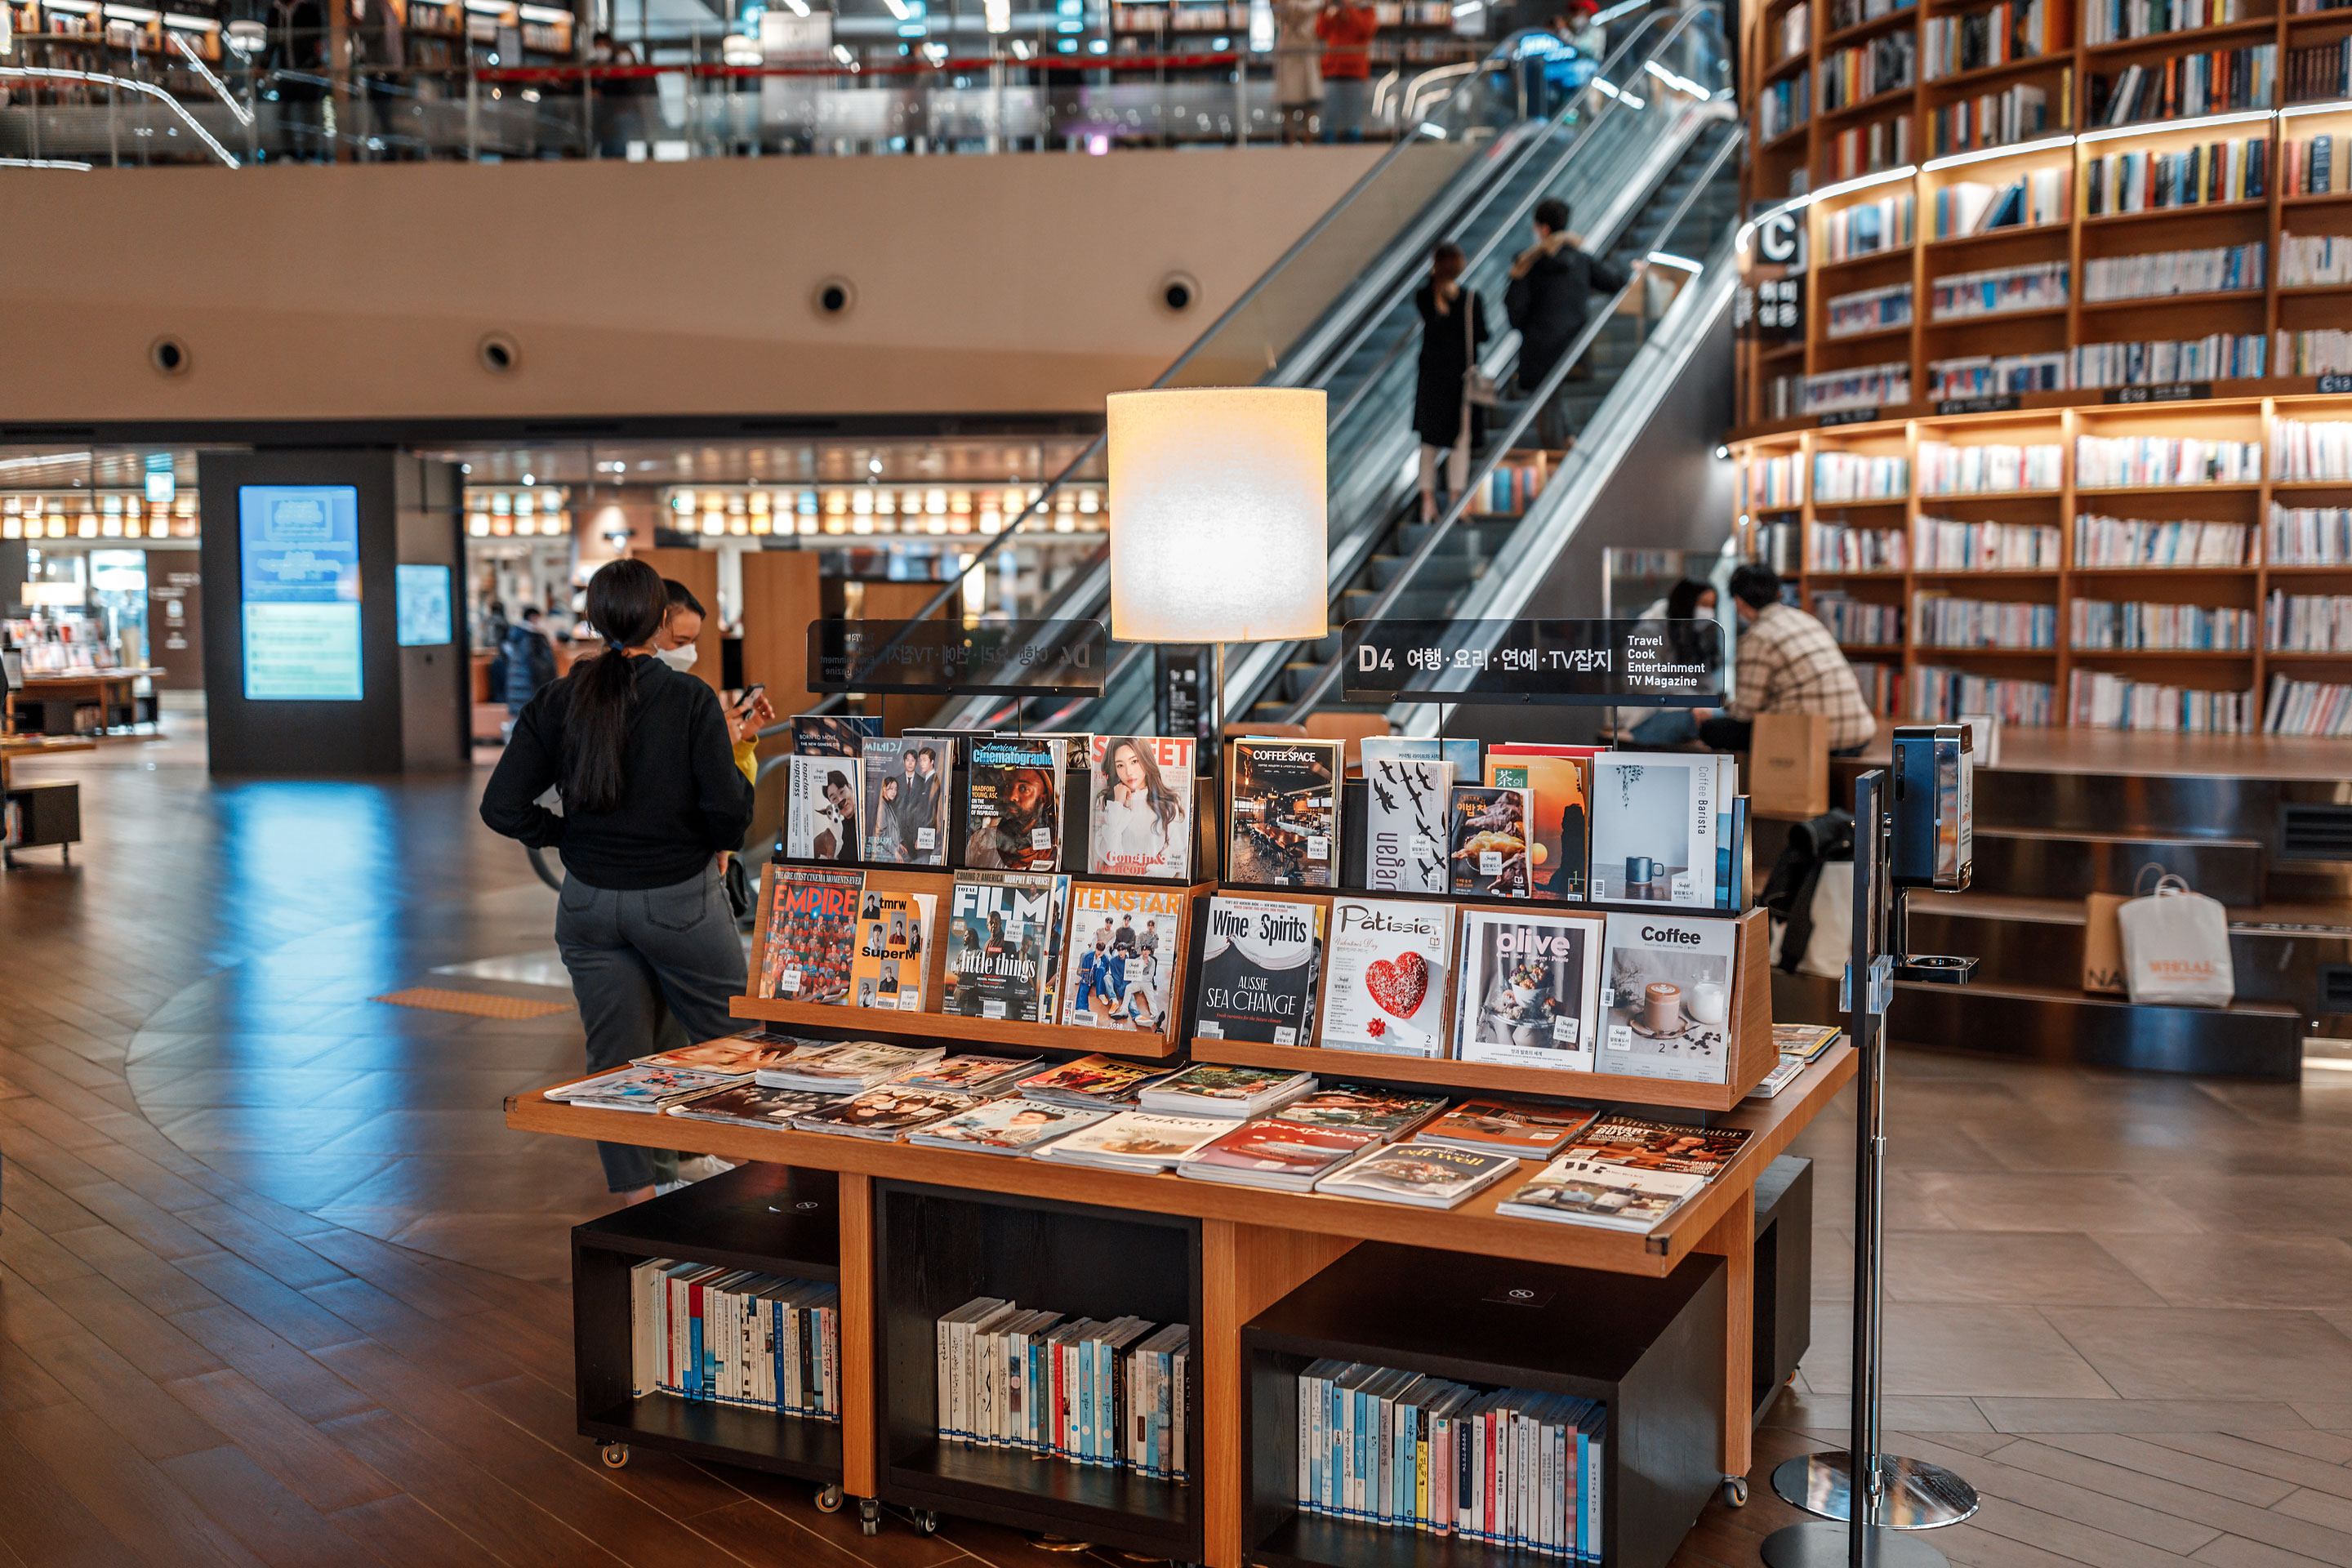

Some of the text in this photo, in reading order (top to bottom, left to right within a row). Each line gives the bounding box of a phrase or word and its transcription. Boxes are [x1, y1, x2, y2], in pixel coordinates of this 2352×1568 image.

[1762, 212, 1796, 261] C
[1628, 635, 1664, 646] Travel
[1359, 644, 1395, 672] D4
[1628, 649, 1655, 660] Cook
[1628, 662, 1706, 674] Entertainment
[1628, 676, 1698, 688] TV Magazine
[863, 740, 902, 755] 씨네21
[981, 742, 1018, 752] American
[973, 750, 1054, 766] Cinematographe
[1253, 751, 1316, 763] COFFEE SPACE
[1697, 766, 1708, 835] Coffee Barista
[775, 871, 783, 880] THE
[783, 872, 807, 882] GREATEST
[807, 873, 825, 883] CINEMA
[825, 875, 849, 884] MOMENTS
[849, 876, 862, 885] EVER
[956, 872, 1050, 886] COMING 2 AMERICA MURPHY RETURNS!
[773, 884, 858, 916] EMPIRE
[880, 898, 906, 911] tmrw
[953, 884, 1049, 923] FILM
[1076, 888, 1179, 914] TENSTAR
[1337, 905, 1441, 935] Pâtissier
[1214, 910, 1249, 938] Wine
[1260, 914, 1307, 947] Spirits
[1642, 926, 1701, 945] Coffee
[1496, 928, 1570, 956] olive
[862, 947, 915, 960] SuperM
[951, 950, 1036, 983] the little things
[1238, 976, 1268, 991] AUSSIE
[1206, 987, 1296, 1015] SEA CHANGE
[1425, 1035, 1432, 1044] 2
[858, 1042, 929, 1057] Living
[1659, 1044, 1665, 1053] 2
[1002, 1099, 1041, 1108] STAR
[1133, 1114, 1214, 1129] bakery
[1611, 1116, 1743, 1138] Wine Spectator
[1594, 1129, 1634, 1138] BUYS
[1601, 1124, 1653, 1135] SMART
[1397, 1148, 1486, 1166] eat well
